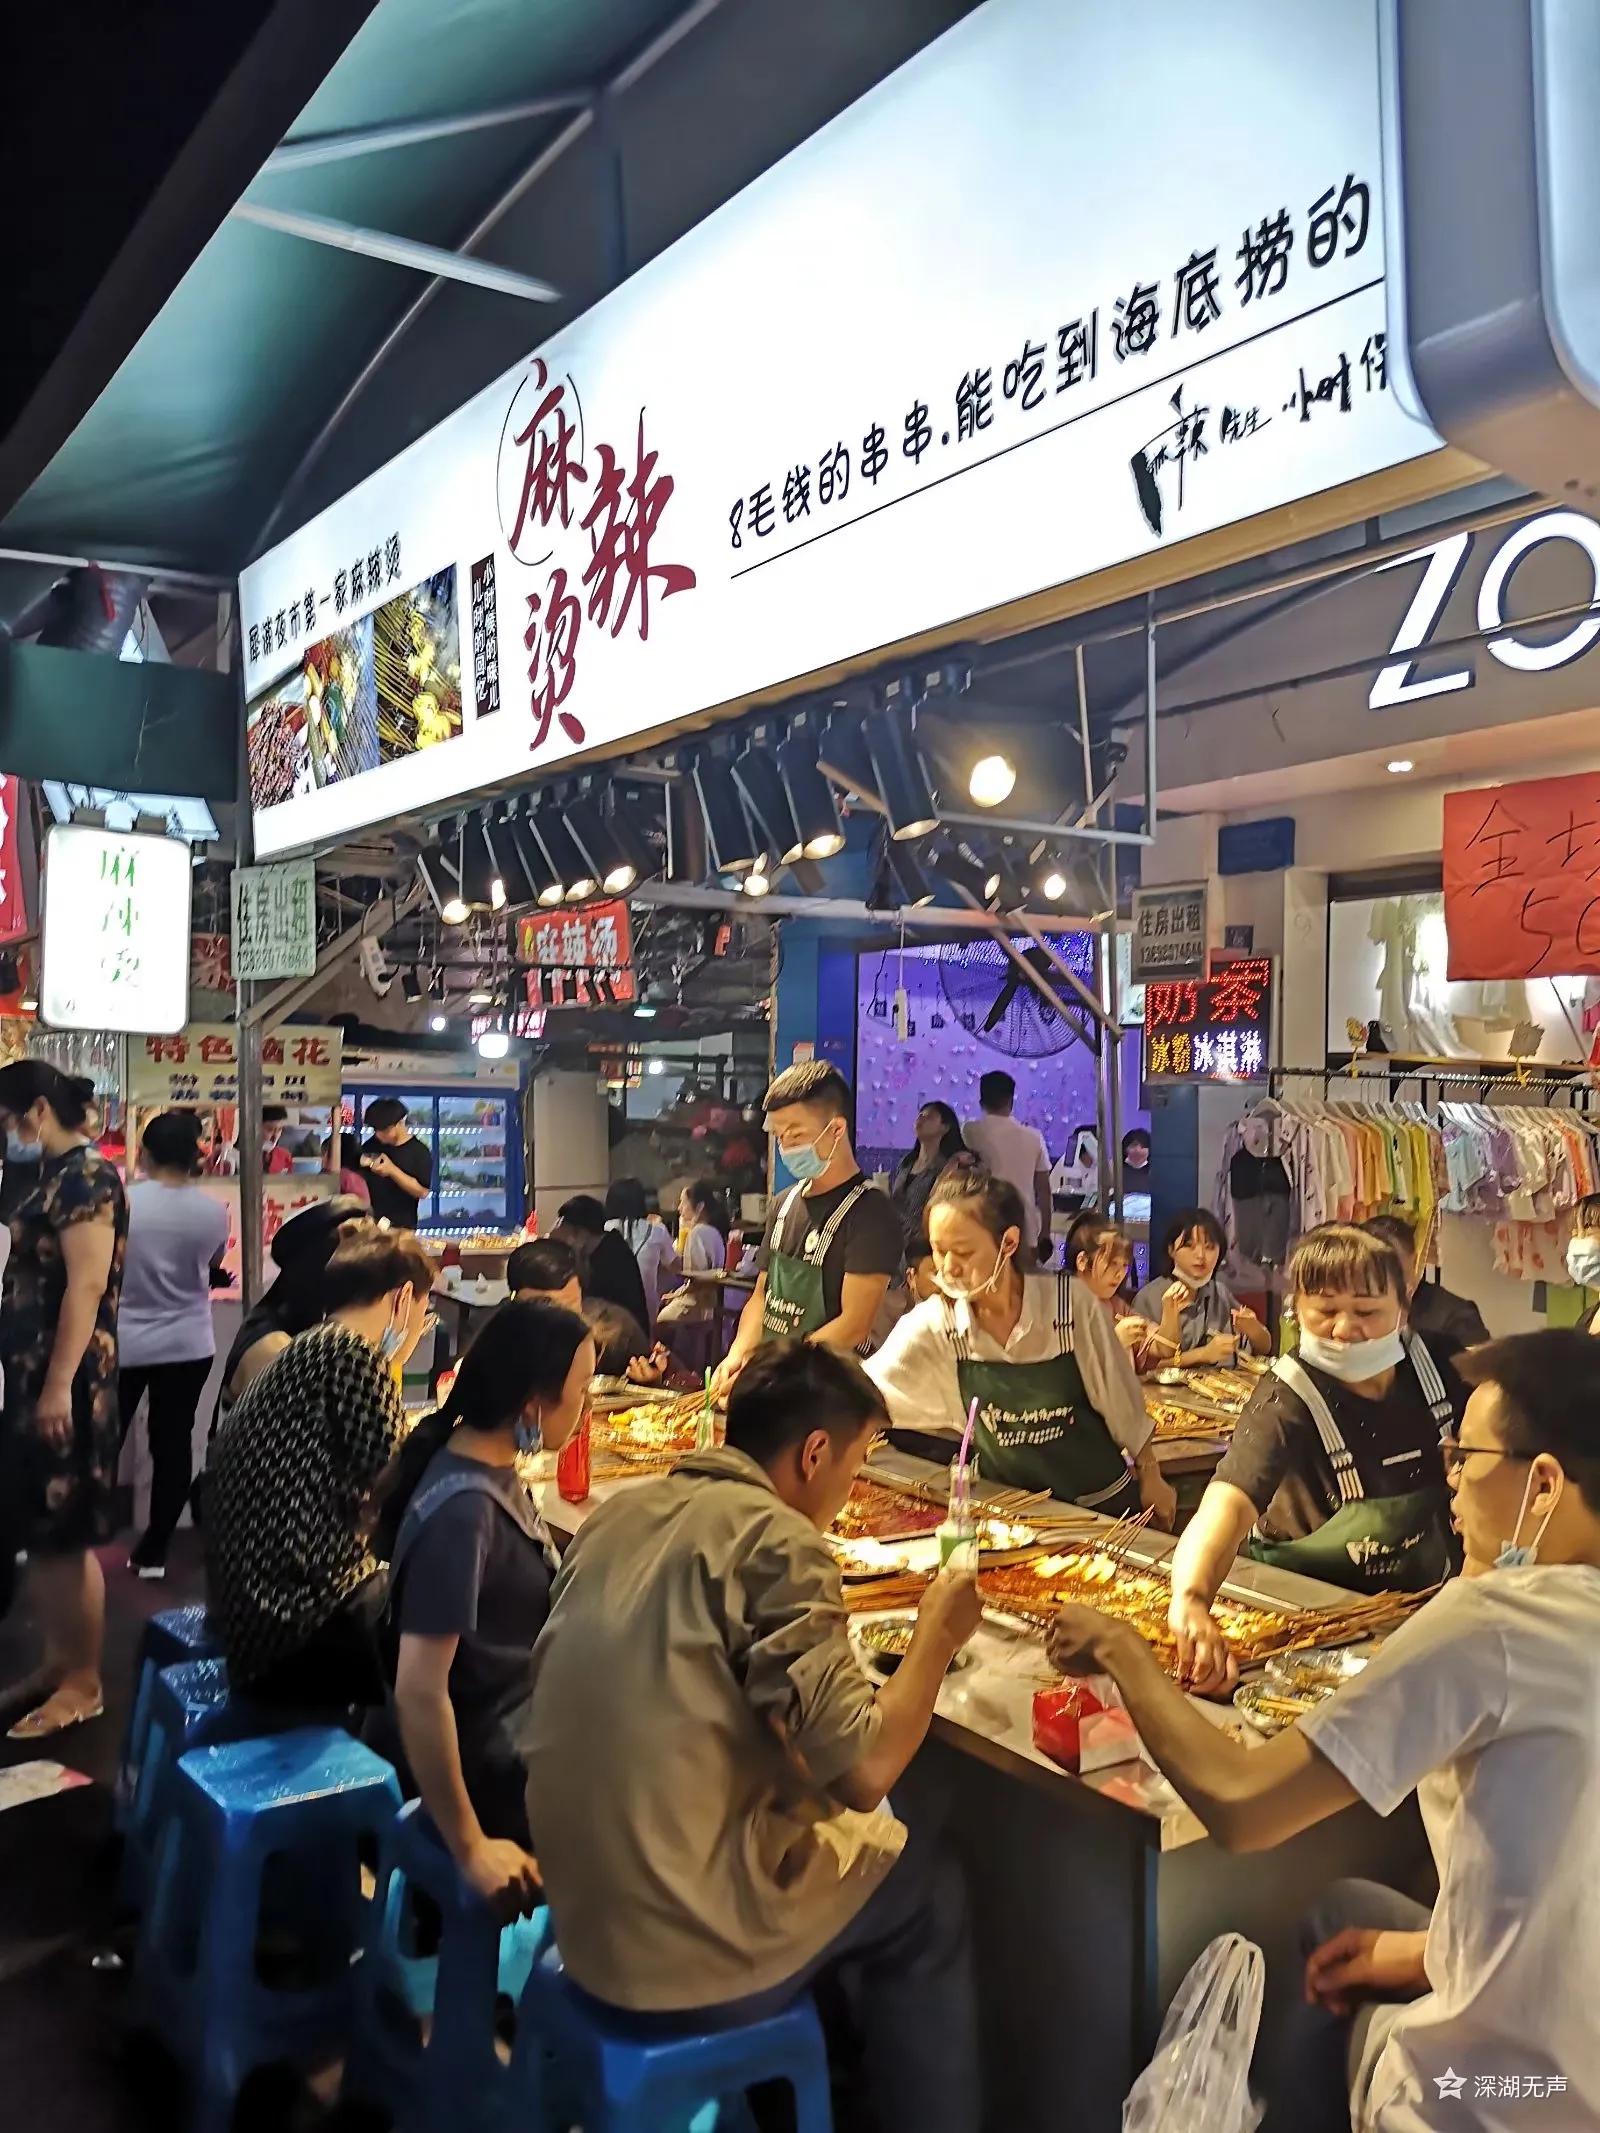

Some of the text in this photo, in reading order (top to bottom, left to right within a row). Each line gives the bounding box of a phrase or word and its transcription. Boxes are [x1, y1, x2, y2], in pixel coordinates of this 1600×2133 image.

[506, 356, 698, 752] 麻辣烫
[1140, 905, 1201, 936] 住房出租
[1149, 964, 1268, 1032] 奶茶
